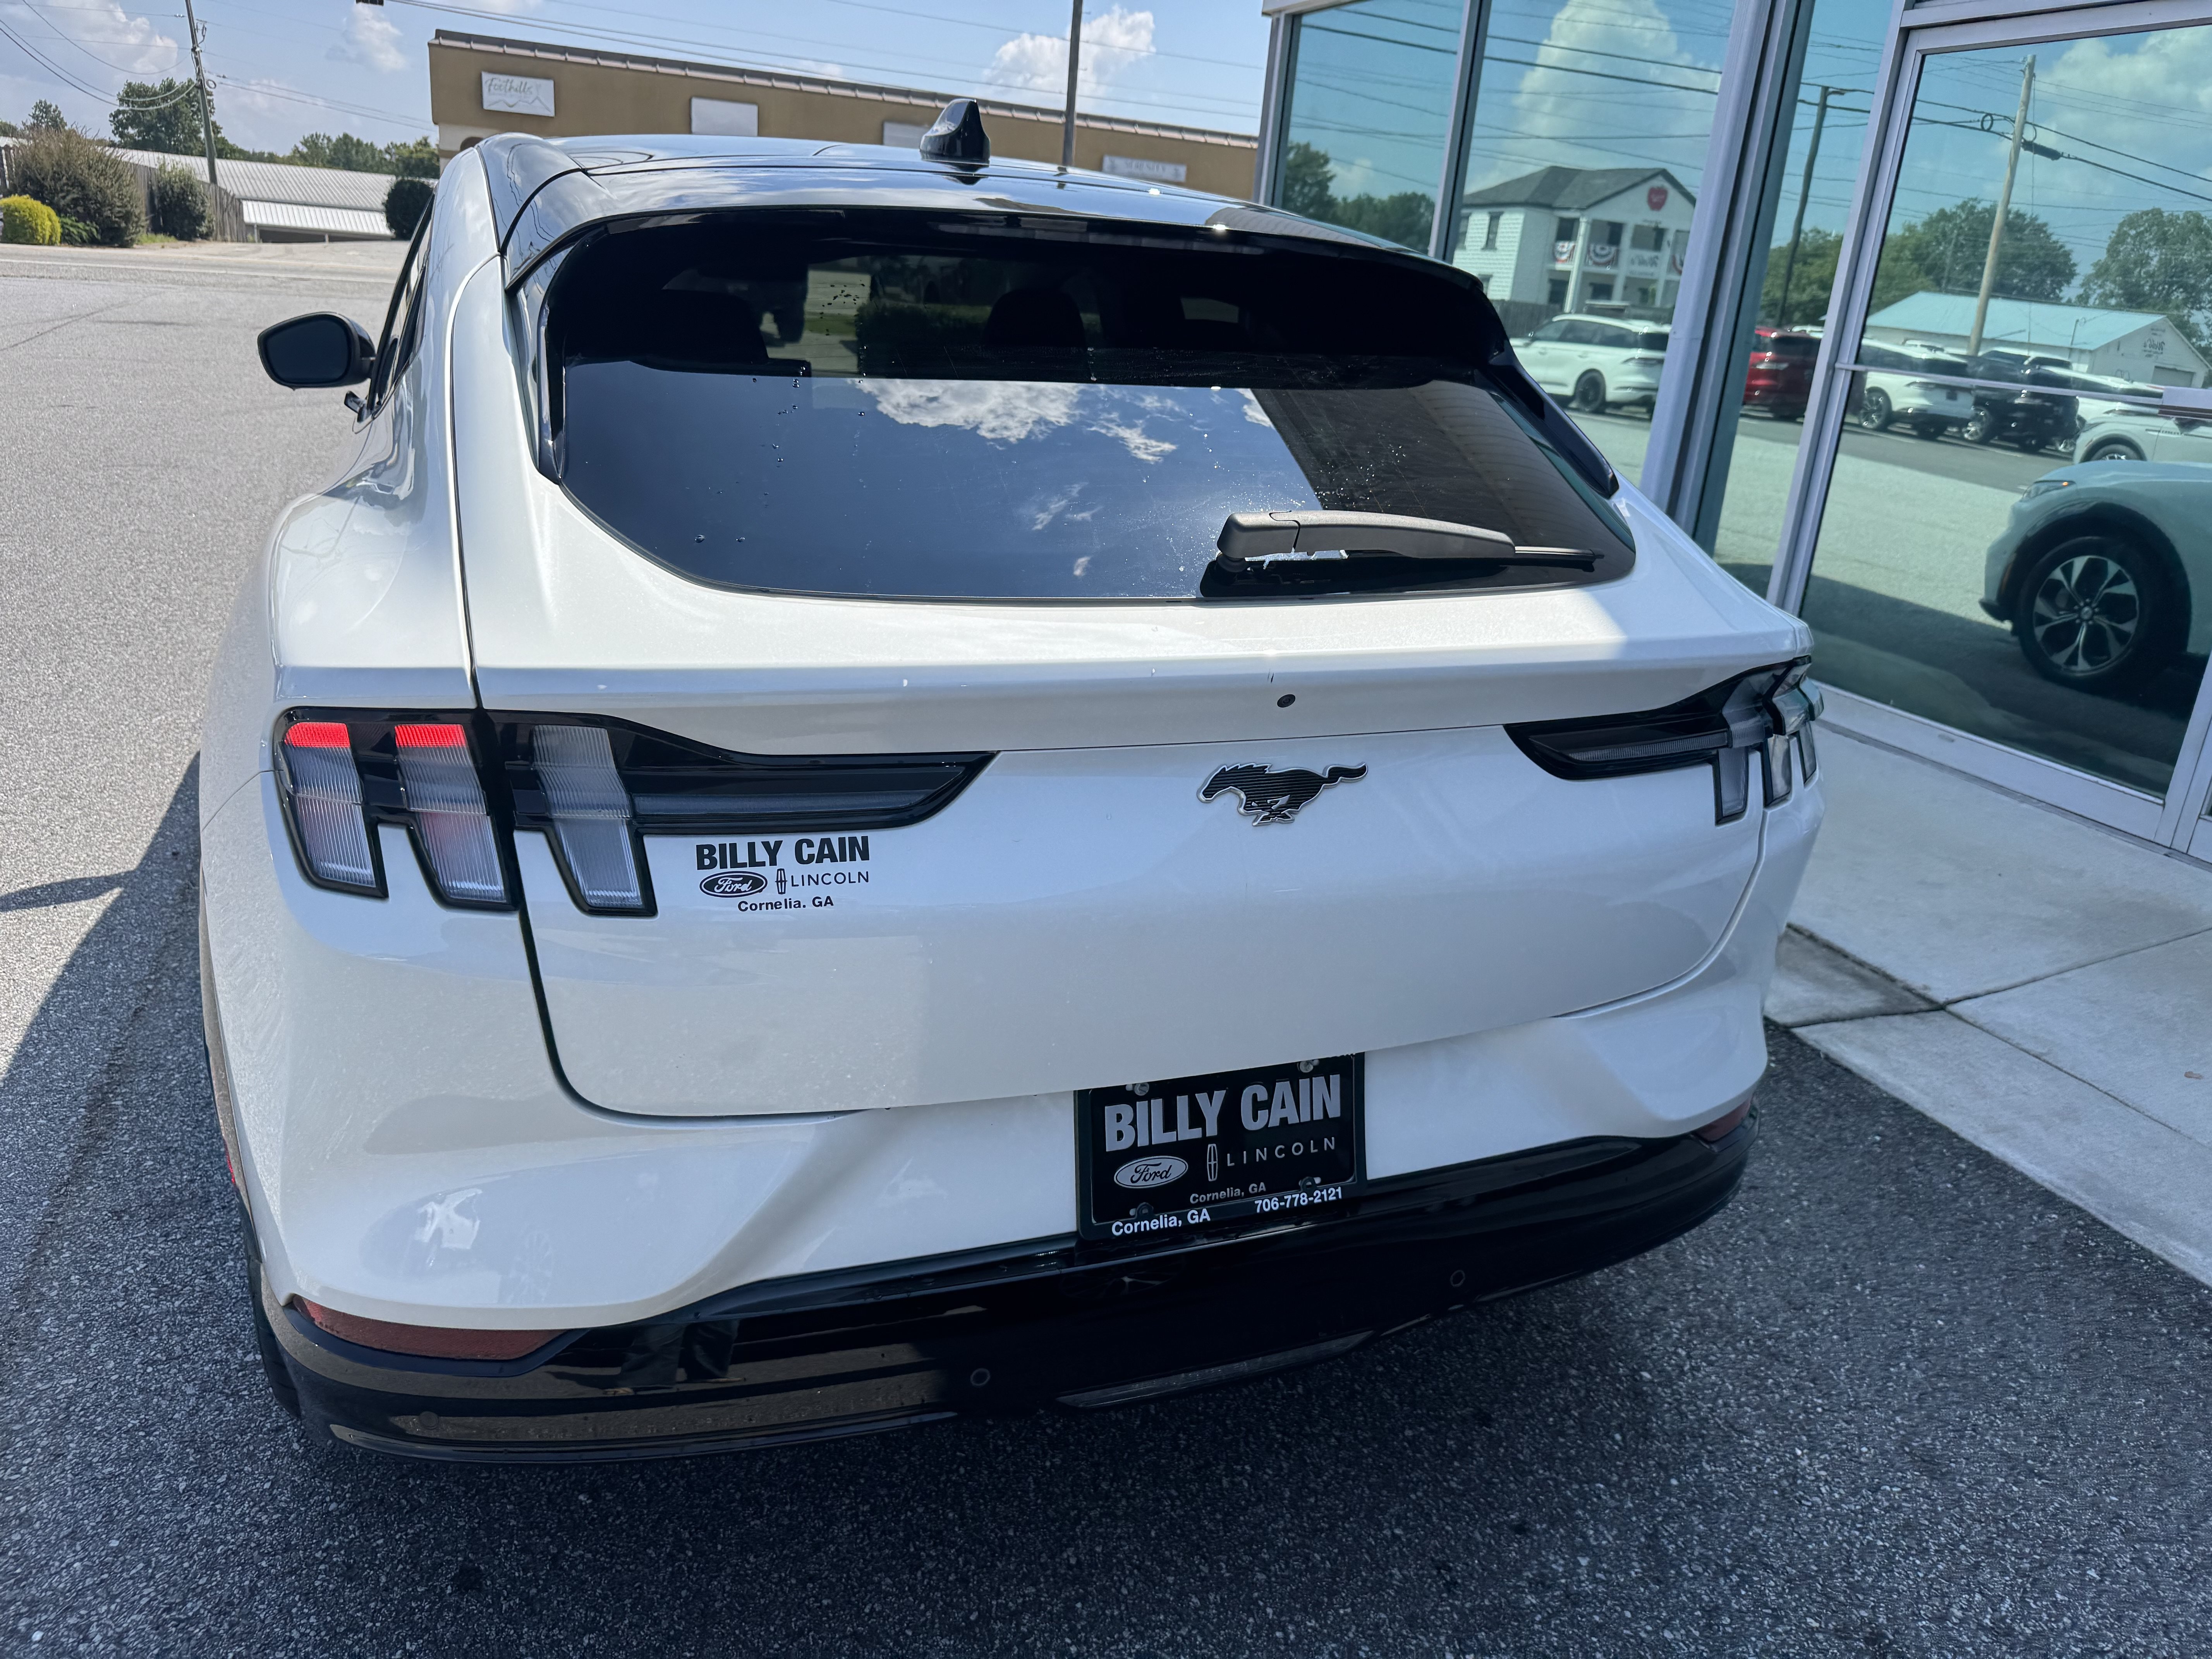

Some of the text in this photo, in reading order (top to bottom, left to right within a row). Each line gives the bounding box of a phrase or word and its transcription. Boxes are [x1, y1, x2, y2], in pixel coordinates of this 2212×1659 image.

[696, 836, 870, 870] BILLY CAIN
[714, 877, 752, 892] Ford
[791, 871, 869, 887] LINCOLN
[812, 896, 834, 907] GA
[1104, 1074, 1341, 1152] BILLY CAIN
[1227, 1137, 1336, 1166] LINCOLN
[1130, 1163, 1172, 1183] Ford
[1190, 1182, 1267, 1204] Cornelia, GA
[1255, 1187, 1343, 1213] 706-778-2121
[1111, 1208, 1211, 1236] Cornelia, GA
